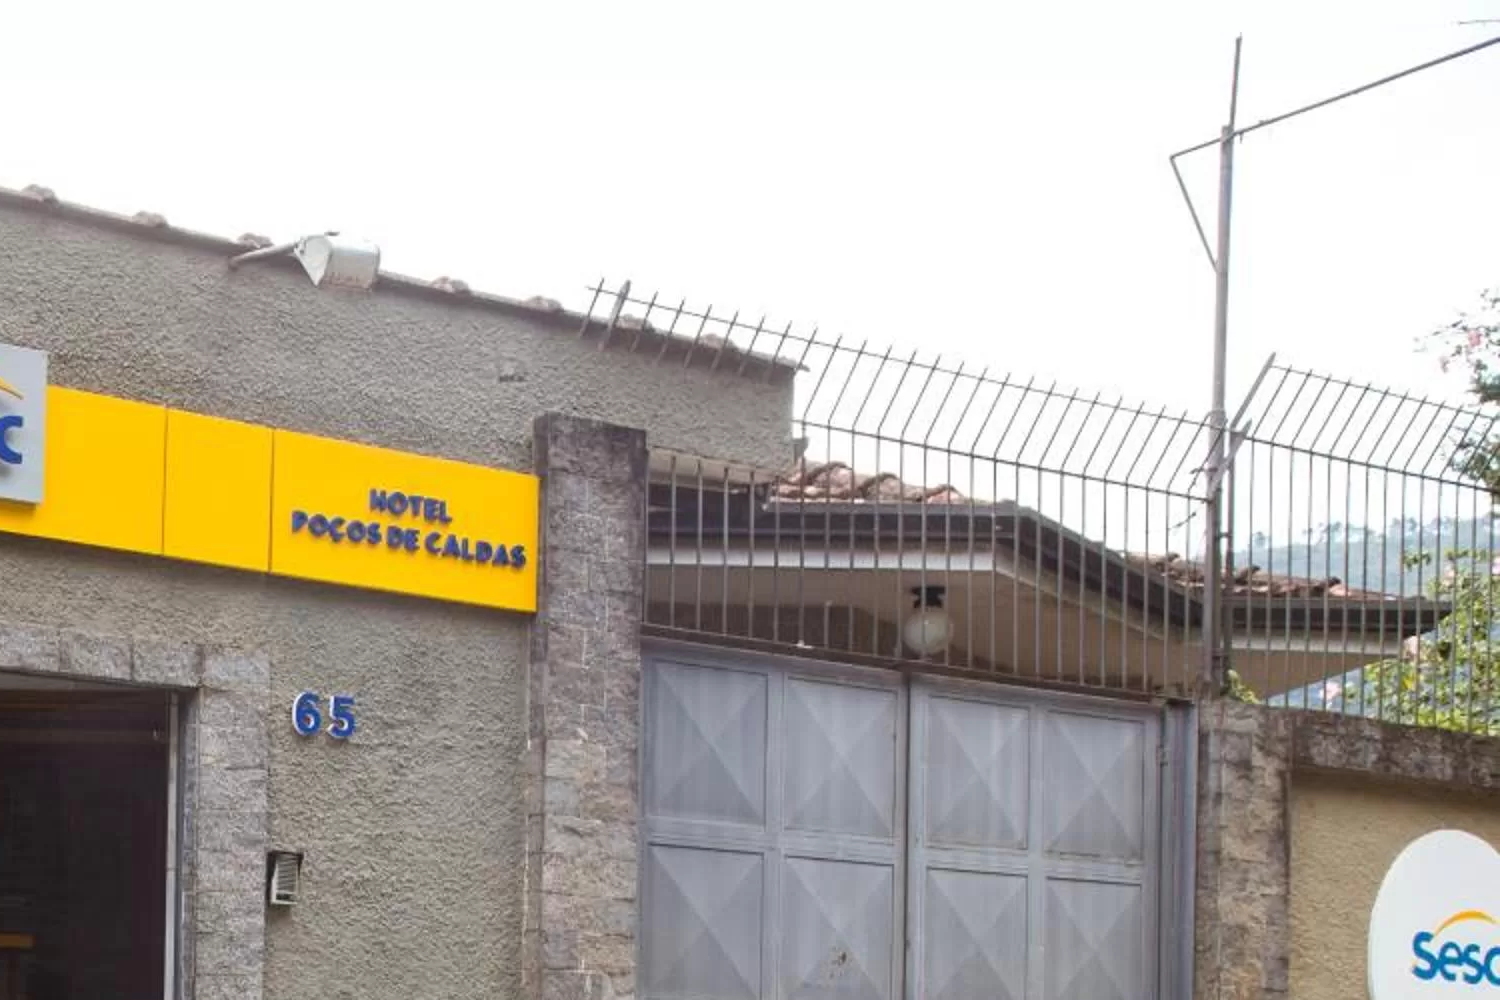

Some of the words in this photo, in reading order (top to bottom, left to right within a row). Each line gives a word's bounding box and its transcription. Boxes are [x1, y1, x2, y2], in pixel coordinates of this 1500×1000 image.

[369, 488, 452, 525] HOTEL
[291, 510, 382, 546] POÇOS
[386, 525, 421, 552] DE
[424, 531, 527, 570] CALDAS
[291, 690, 357, 739] 65
